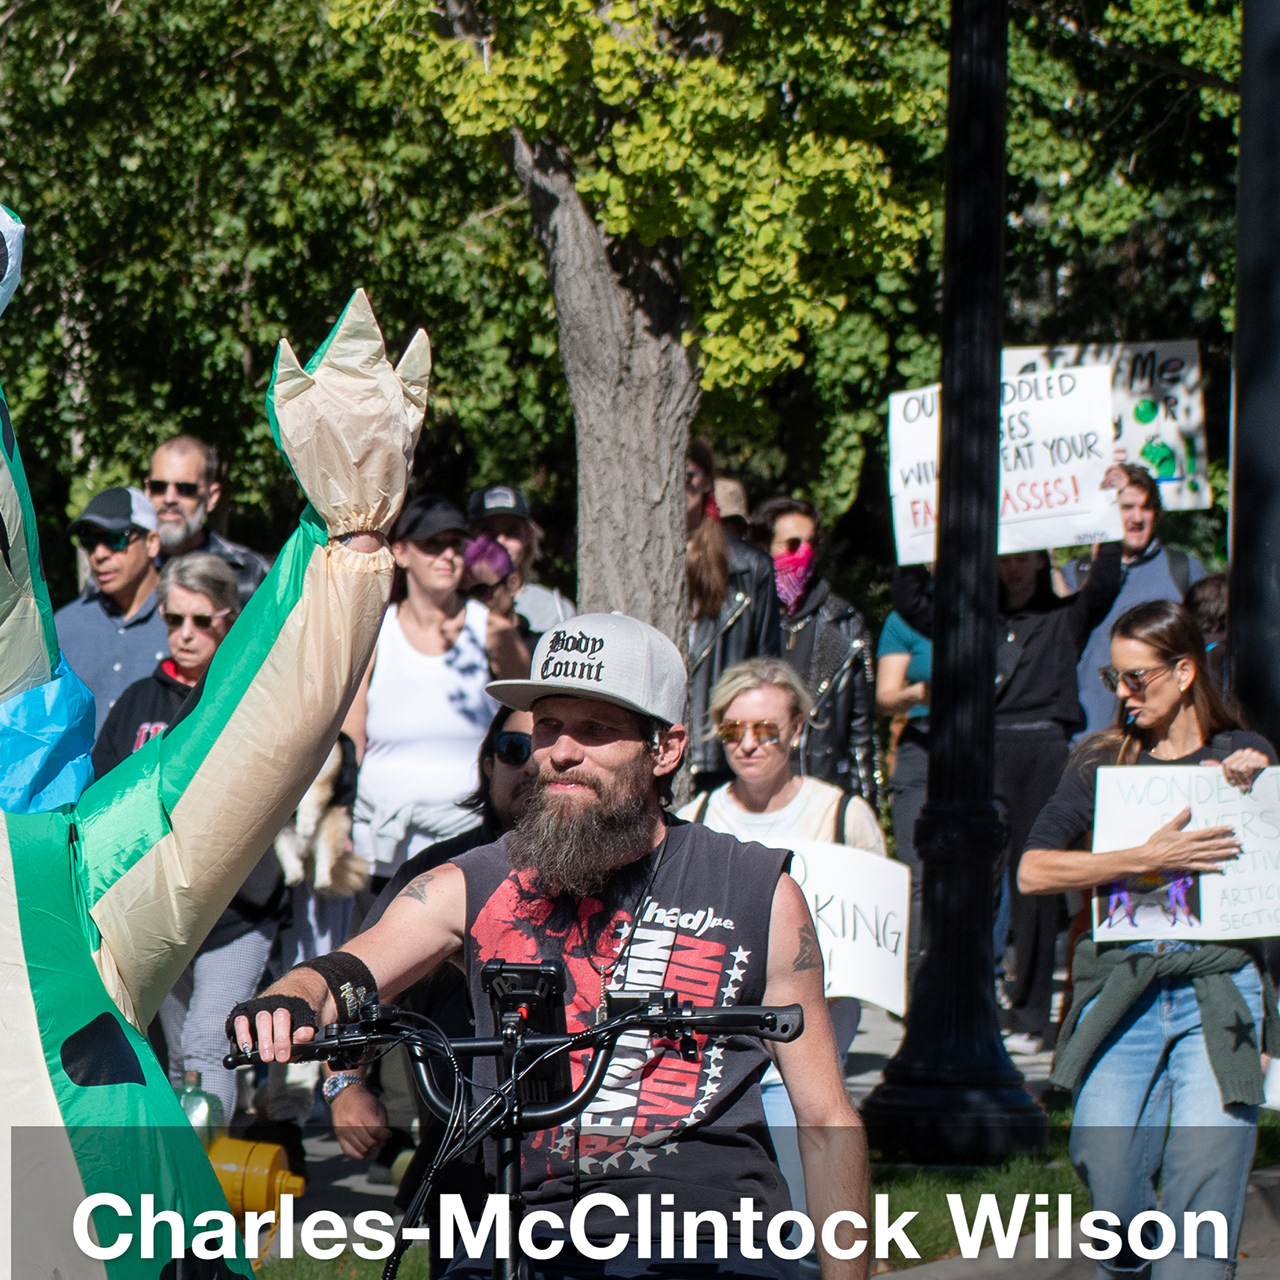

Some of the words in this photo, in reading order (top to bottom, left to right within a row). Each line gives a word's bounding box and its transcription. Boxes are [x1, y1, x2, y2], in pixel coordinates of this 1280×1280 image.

[903, 391, 940, 423] OU
[1000, 374, 1076, 406] DDLED
[1042, 431, 1104, 467] YOUR
[910, 500, 938, 529] FA
[1000, 475, 1080, 518] ASSES!
[546, 630, 604, 660] Body
[541, 656, 605, 682] Count
[1115, 774, 1257, 806] WONDE
[814, 893, 902, 957] KING
